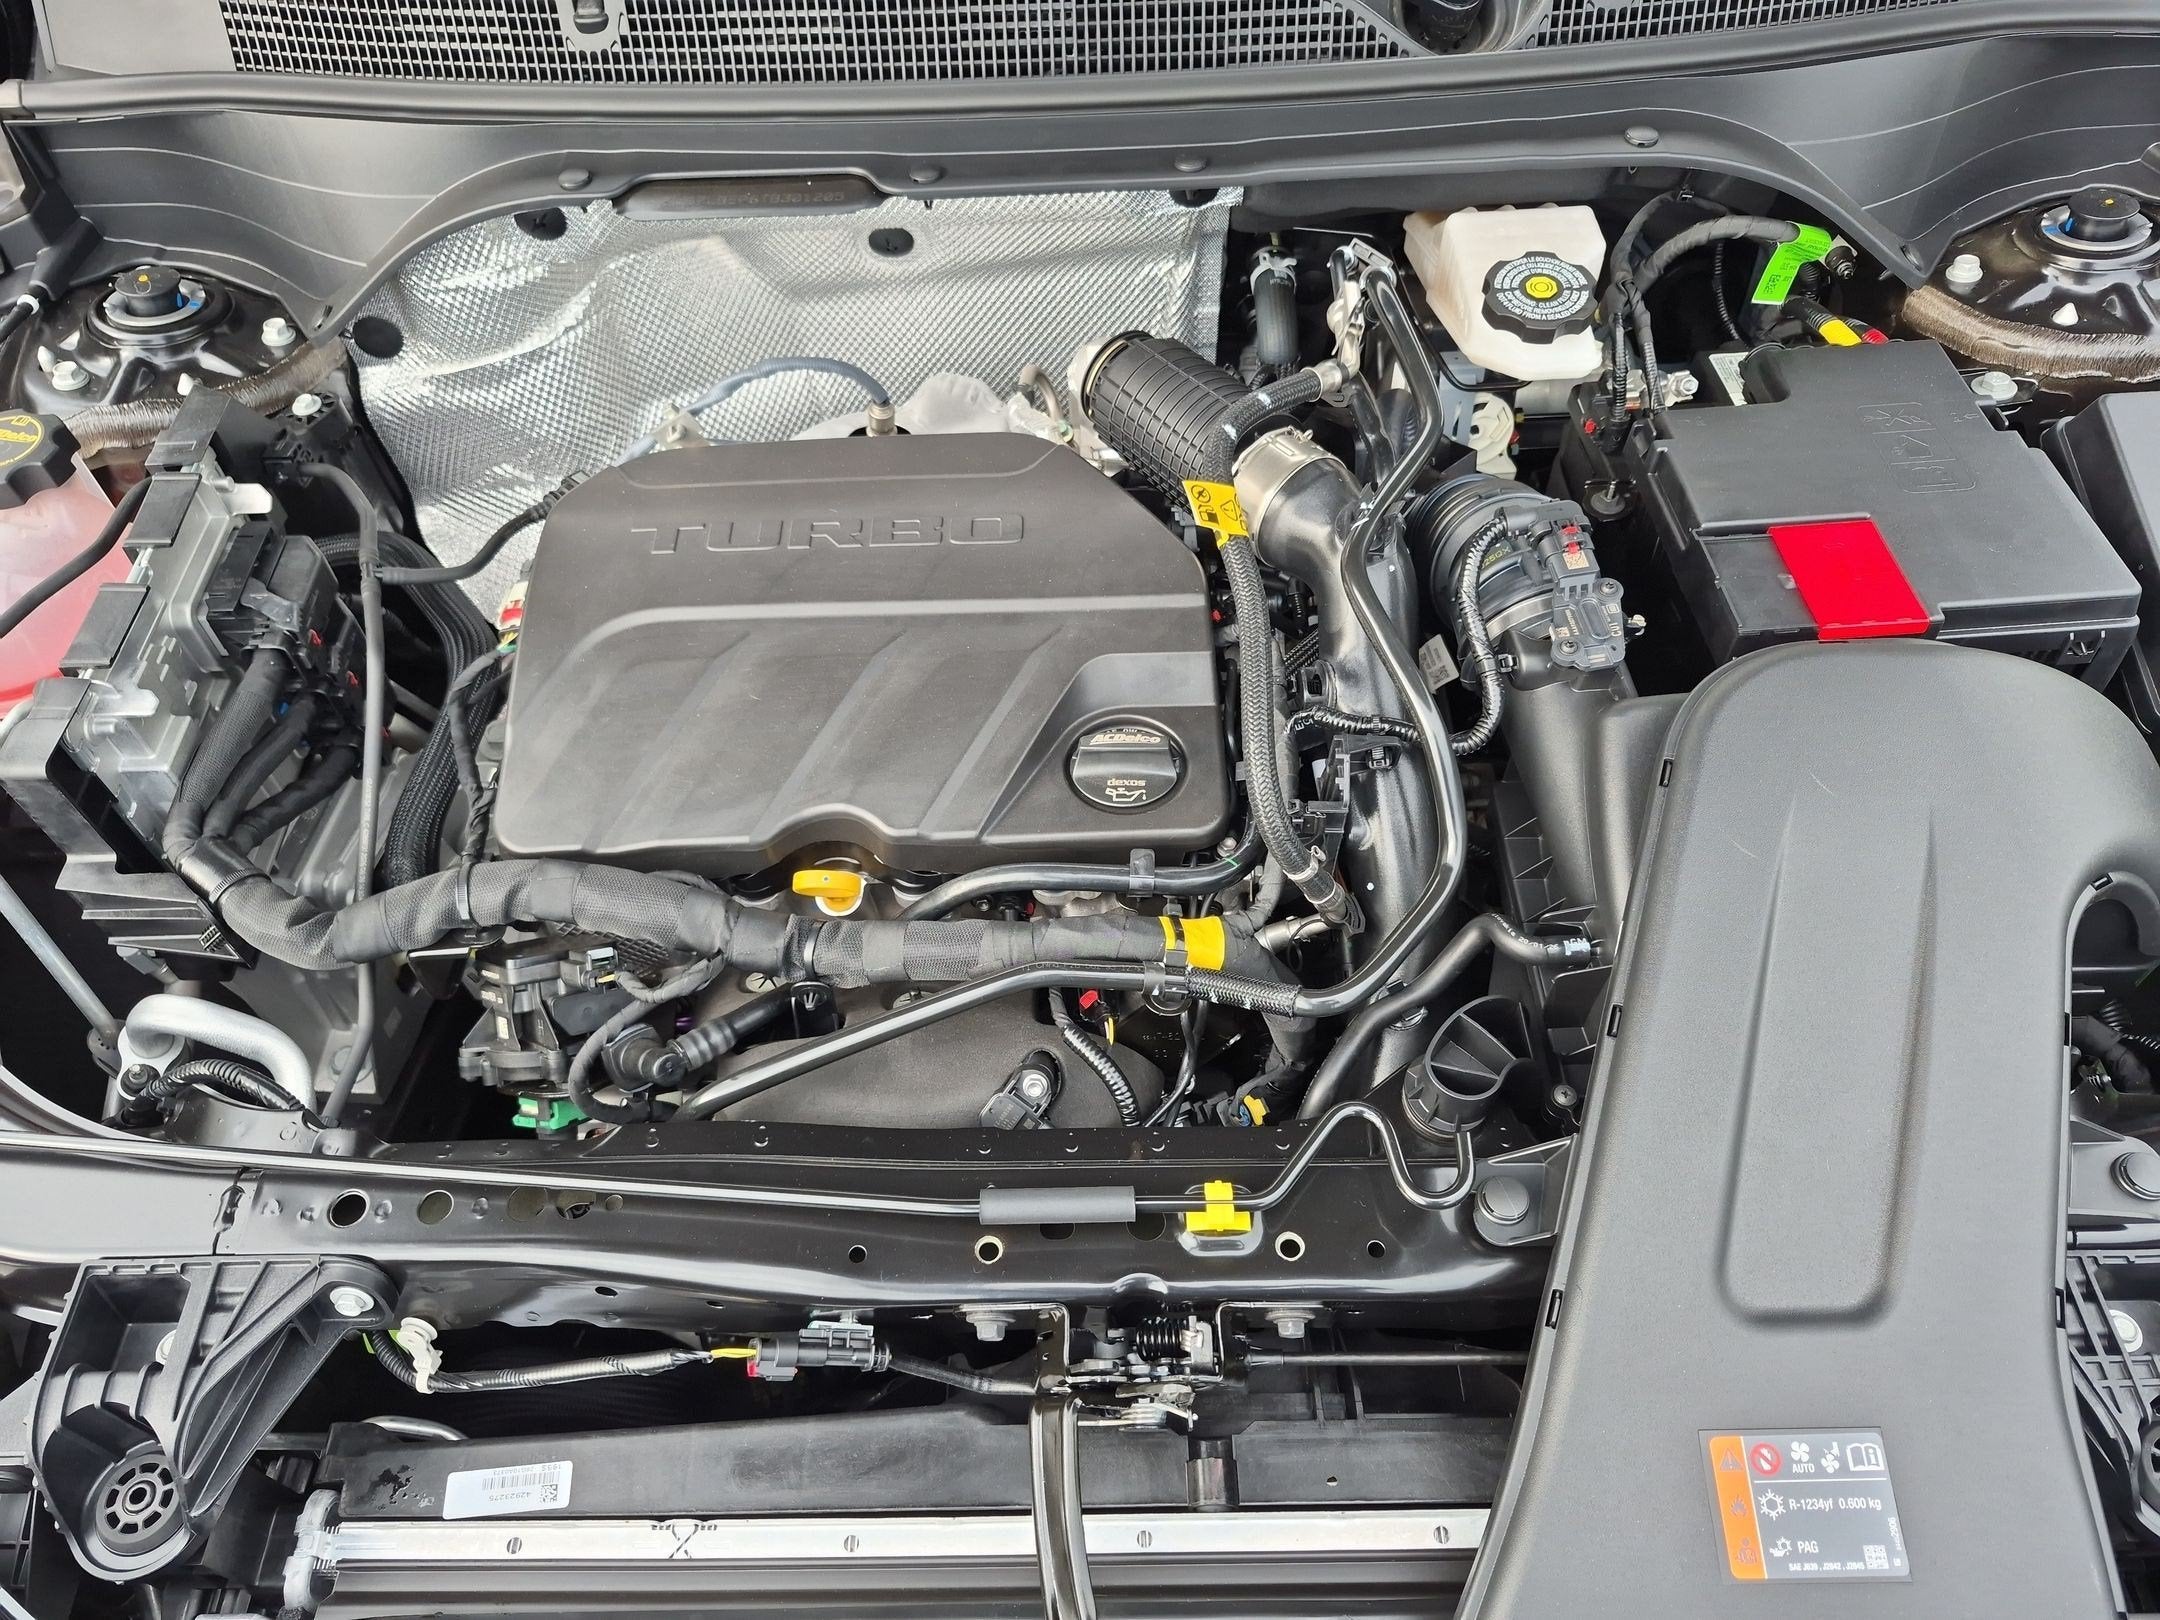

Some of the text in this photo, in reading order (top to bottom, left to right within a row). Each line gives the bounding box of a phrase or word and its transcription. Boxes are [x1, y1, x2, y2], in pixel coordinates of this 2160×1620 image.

[630, 514, 1024, 555] TURBO
[1089, 733, 1161, 745] ACDelco
[1107, 777, 1146, 786] dexos
[1792, 1463, 1815, 1474] AUTO
[1789, 1497, 1882, 1512] R-1234yf 0.600 kg
[1797, 1541, 1819, 1554] PAG
[1788, 1563, 1802, 1571] SAE
